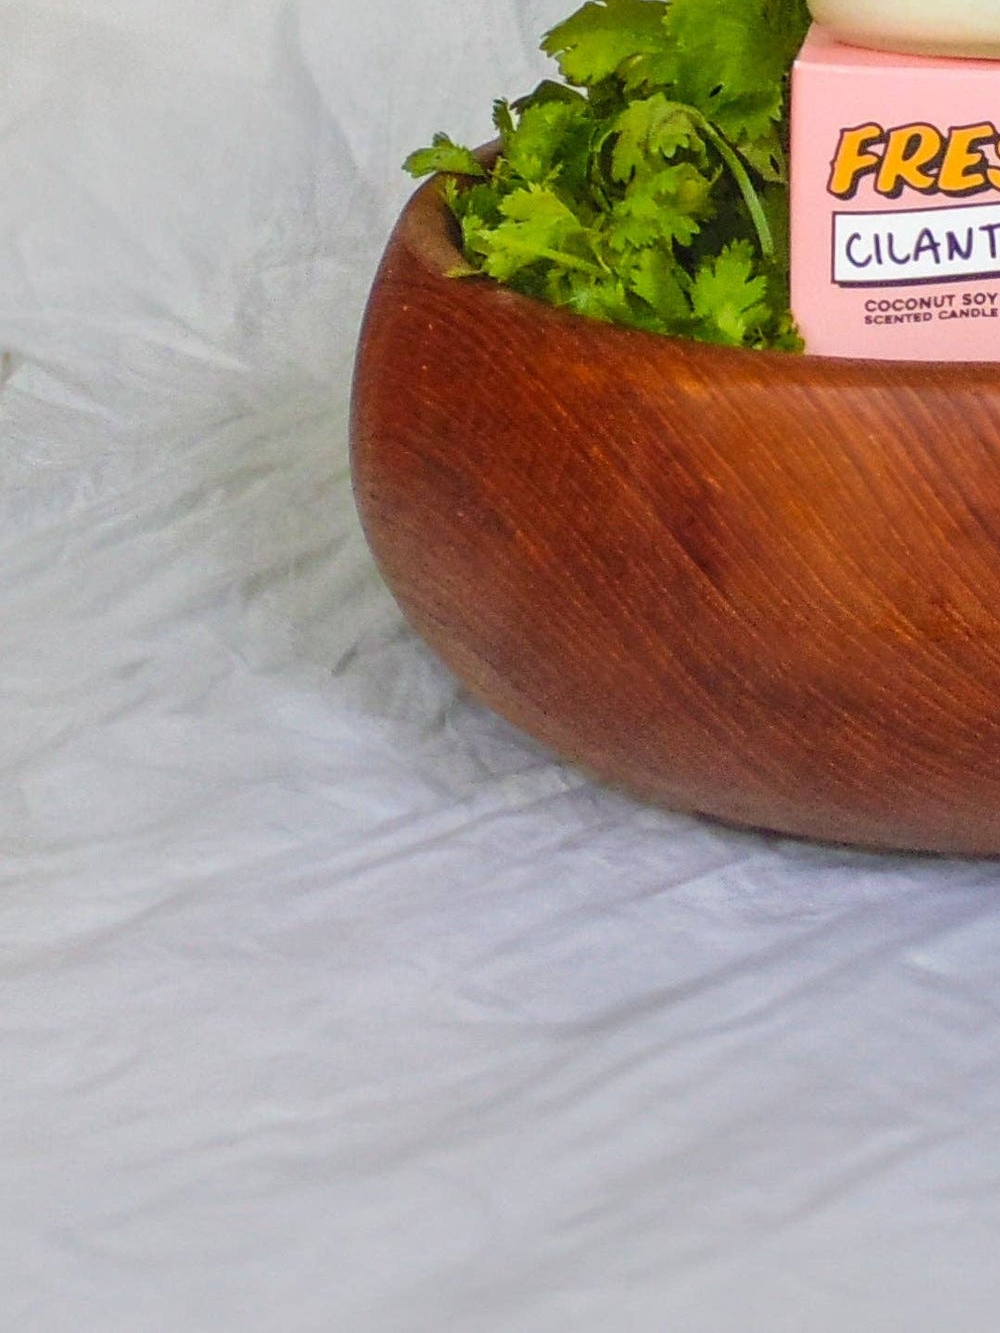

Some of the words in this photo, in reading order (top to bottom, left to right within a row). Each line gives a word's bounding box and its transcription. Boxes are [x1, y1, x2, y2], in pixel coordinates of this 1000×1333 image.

[864, 294, 955, 313] COCONUT
[962, 292, 998, 307] SOY
[864, 312, 933, 325] SCENTED
[938, 307, 999, 320] CANDLE
